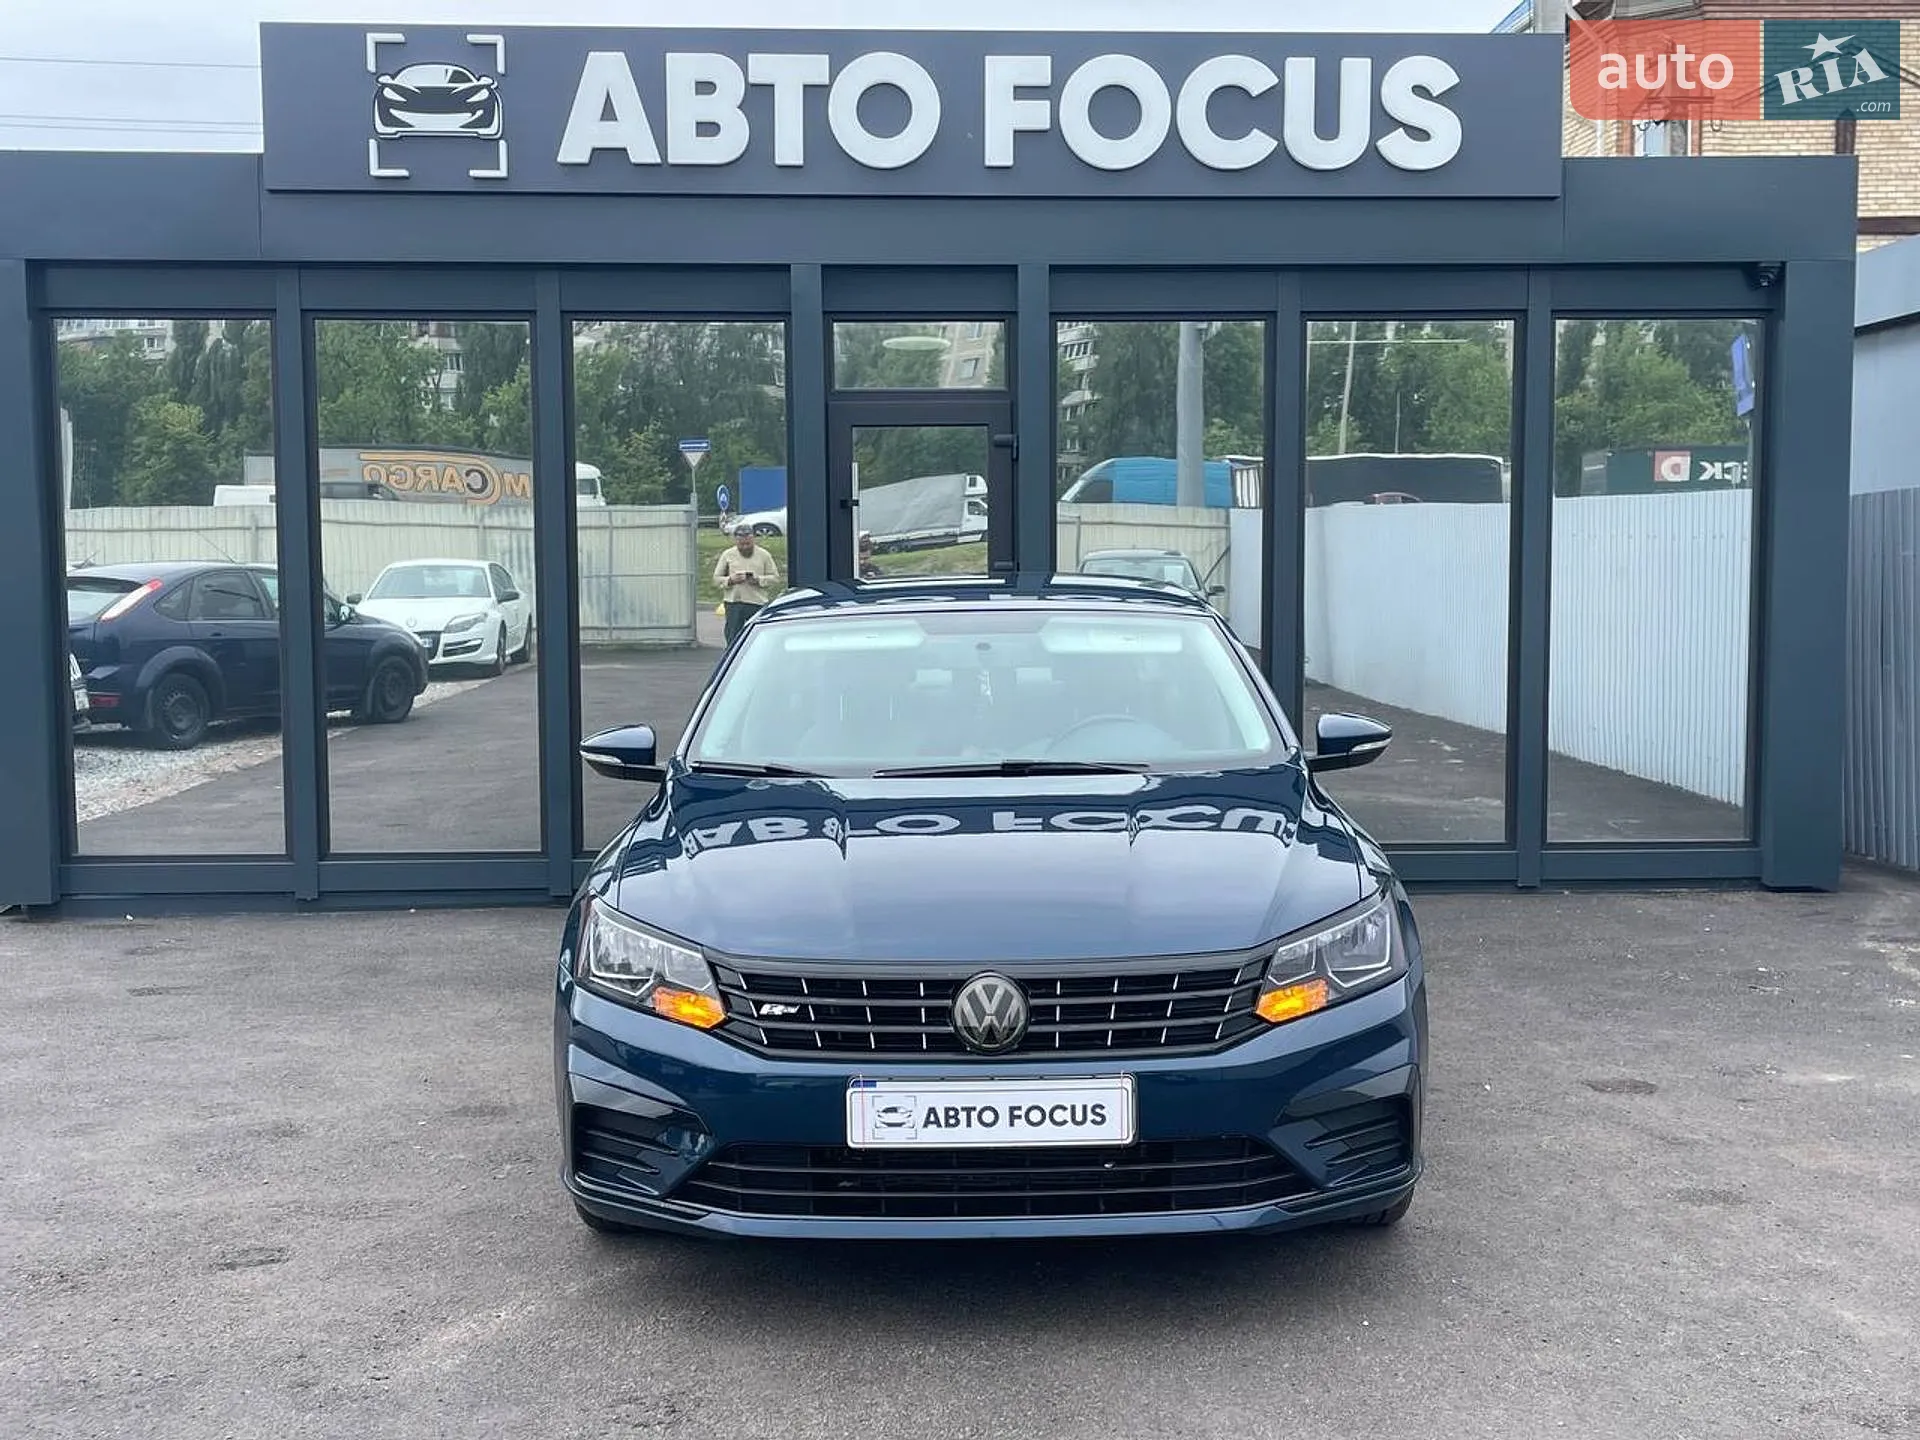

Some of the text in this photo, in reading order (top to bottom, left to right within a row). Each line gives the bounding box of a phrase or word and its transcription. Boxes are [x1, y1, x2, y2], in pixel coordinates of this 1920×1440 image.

[556, 51, 1462, 171] АВТО FOCUS
[922, 1103, 1107, 1129] АВТО FOCUS
